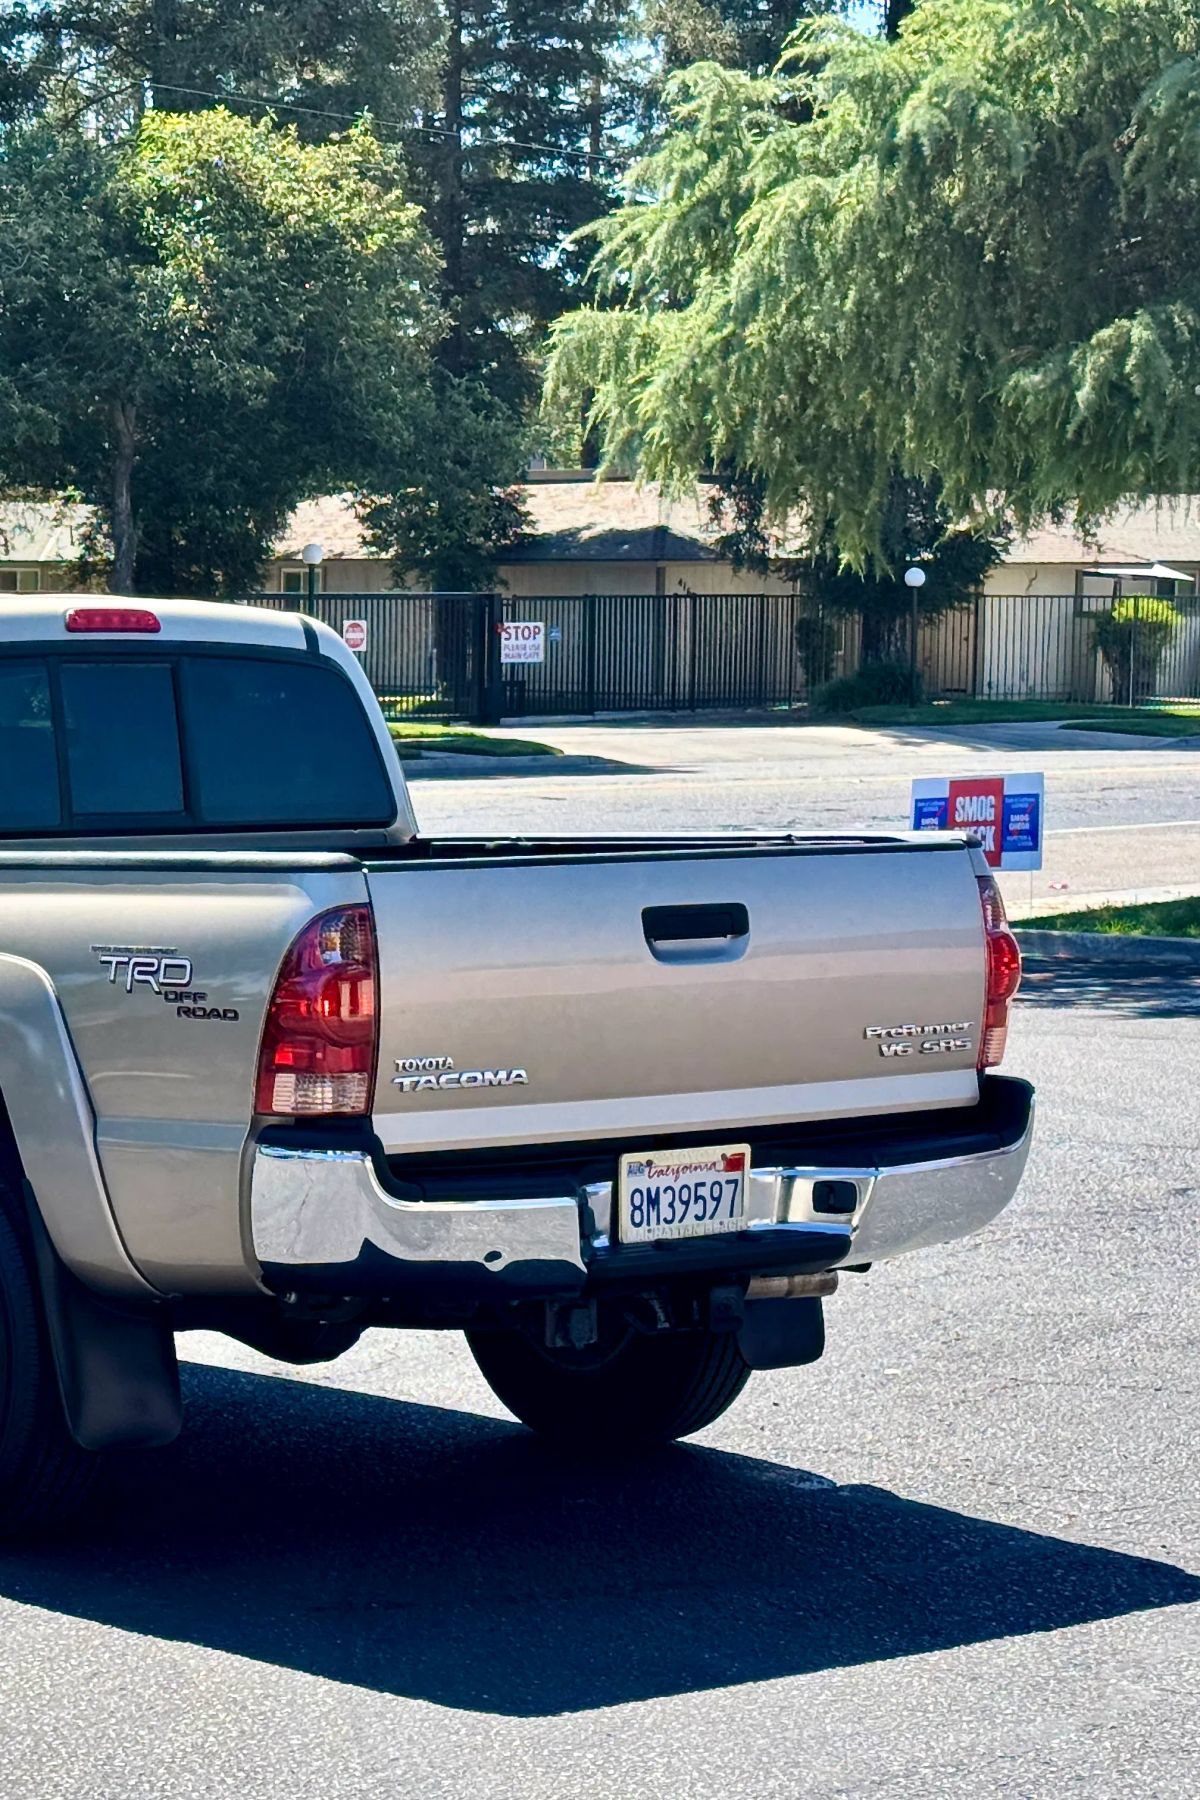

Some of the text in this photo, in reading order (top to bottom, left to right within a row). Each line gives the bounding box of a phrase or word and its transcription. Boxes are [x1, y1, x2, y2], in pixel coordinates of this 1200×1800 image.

[503, 626, 541, 641] STOP
[955, 796, 996, 822] SMOG
[100, 955, 193, 994] TRD
[164, 991, 208, 1004] OFF
[177, 1006, 239, 1022] ROAD
[879, 1042, 914, 1057] V6
[394, 1057, 454, 1071] TOYOTA
[392, 1069, 529, 1092] TACOMA
[646, 1161, 718, 1182] California
[630, 1179, 739, 1228] 8M39597
